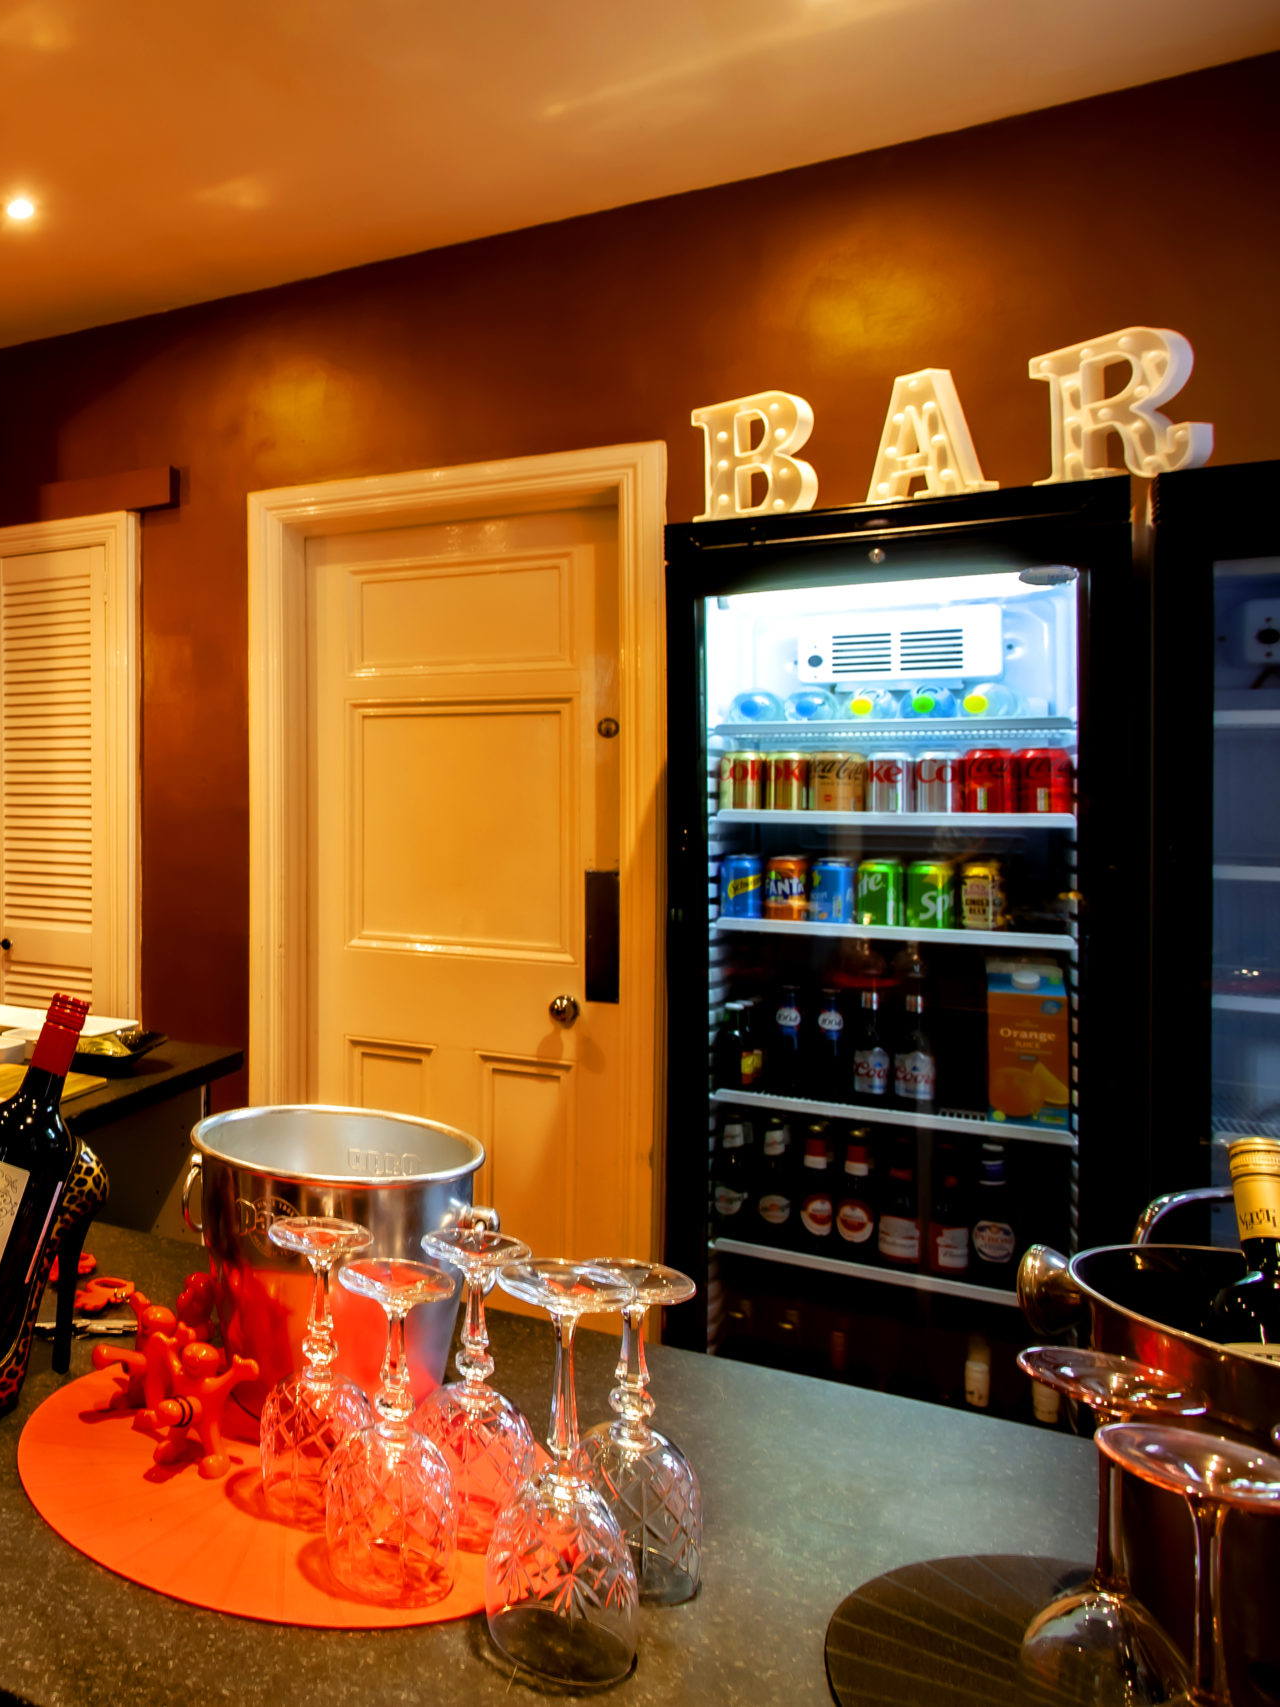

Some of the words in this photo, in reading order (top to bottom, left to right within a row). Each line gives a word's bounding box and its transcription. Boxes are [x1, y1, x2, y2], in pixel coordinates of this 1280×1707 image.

[691, 327, 1214, 523] BAR
[867, 759, 903, 784] ke
[917, 758, 960, 784] Co
[857, 872, 883, 899] ite
[999, 1027, 1056, 1043] Orange
